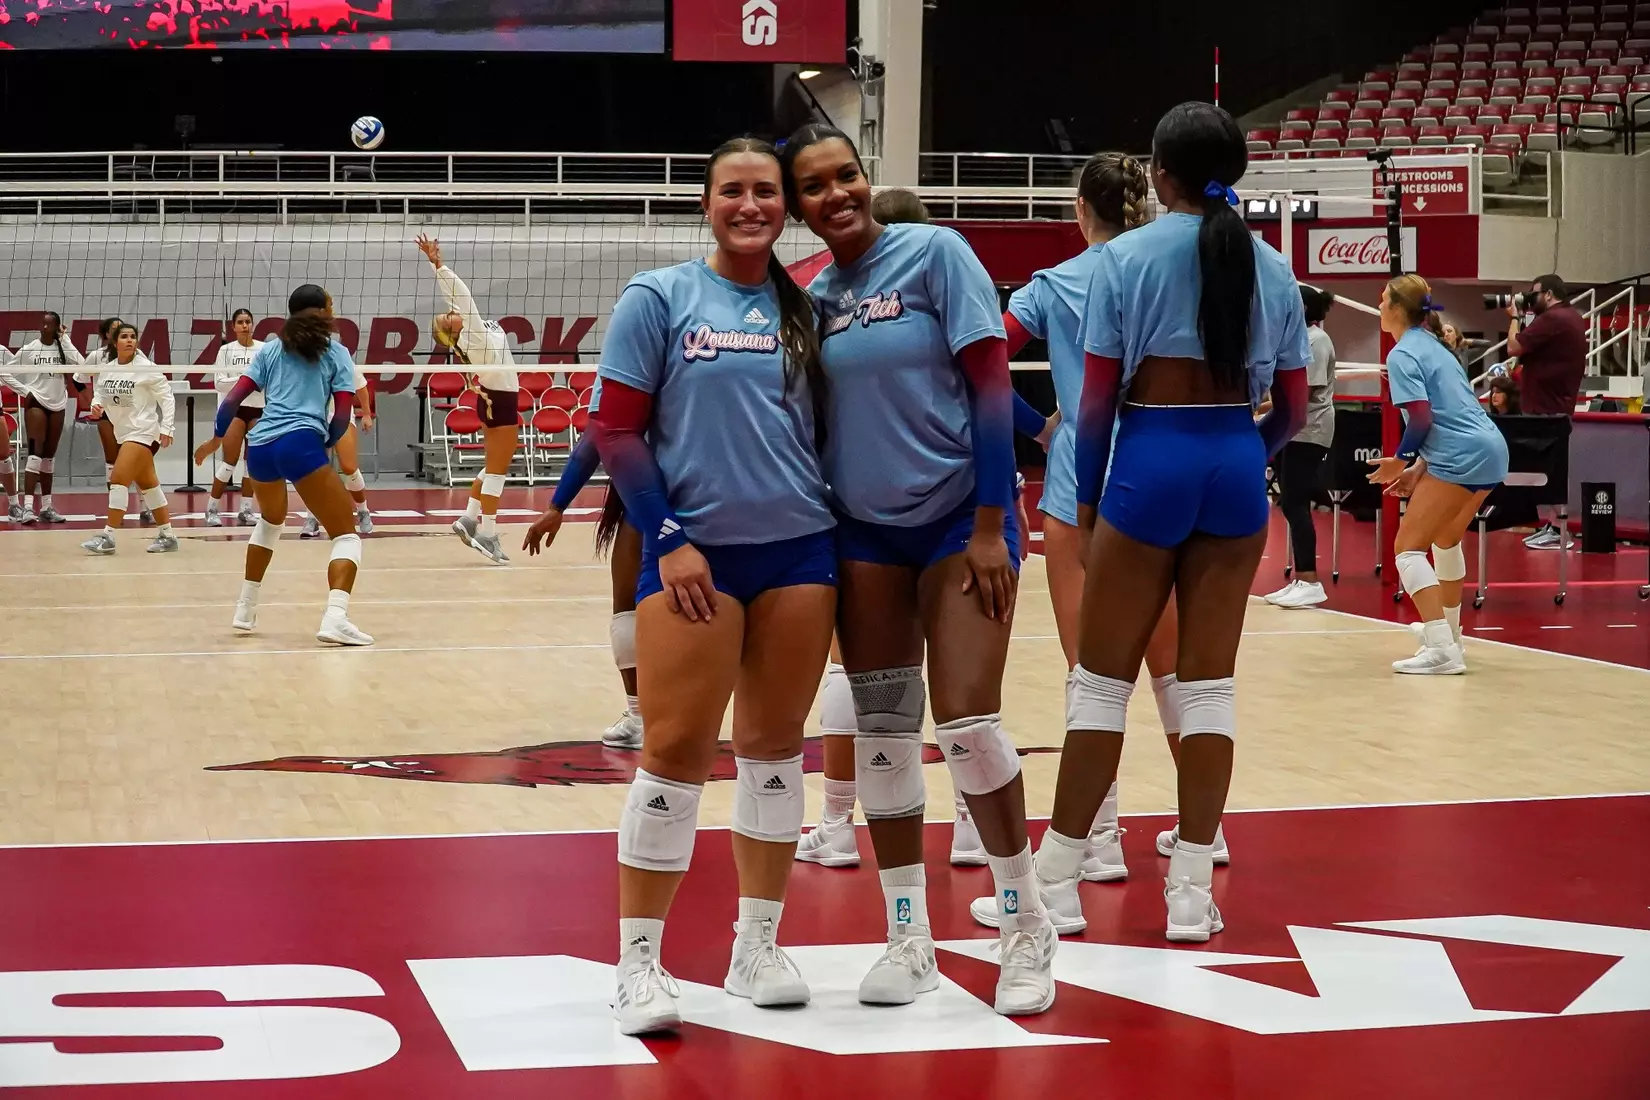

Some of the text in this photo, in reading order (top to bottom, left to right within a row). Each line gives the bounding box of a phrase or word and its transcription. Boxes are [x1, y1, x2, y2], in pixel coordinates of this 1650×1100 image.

[1387, 171, 1454, 181] RESTROOMS
[1401, 183, 1464, 194] NCESSIONS
[1318, 235, 1390, 266] Coca-Col
[855, 290, 904, 328] Tech
[683, 324, 778, 362] Louisiana
[104, 380, 119, 388] ITTLE
[647, 802, 670, 812] adidas
